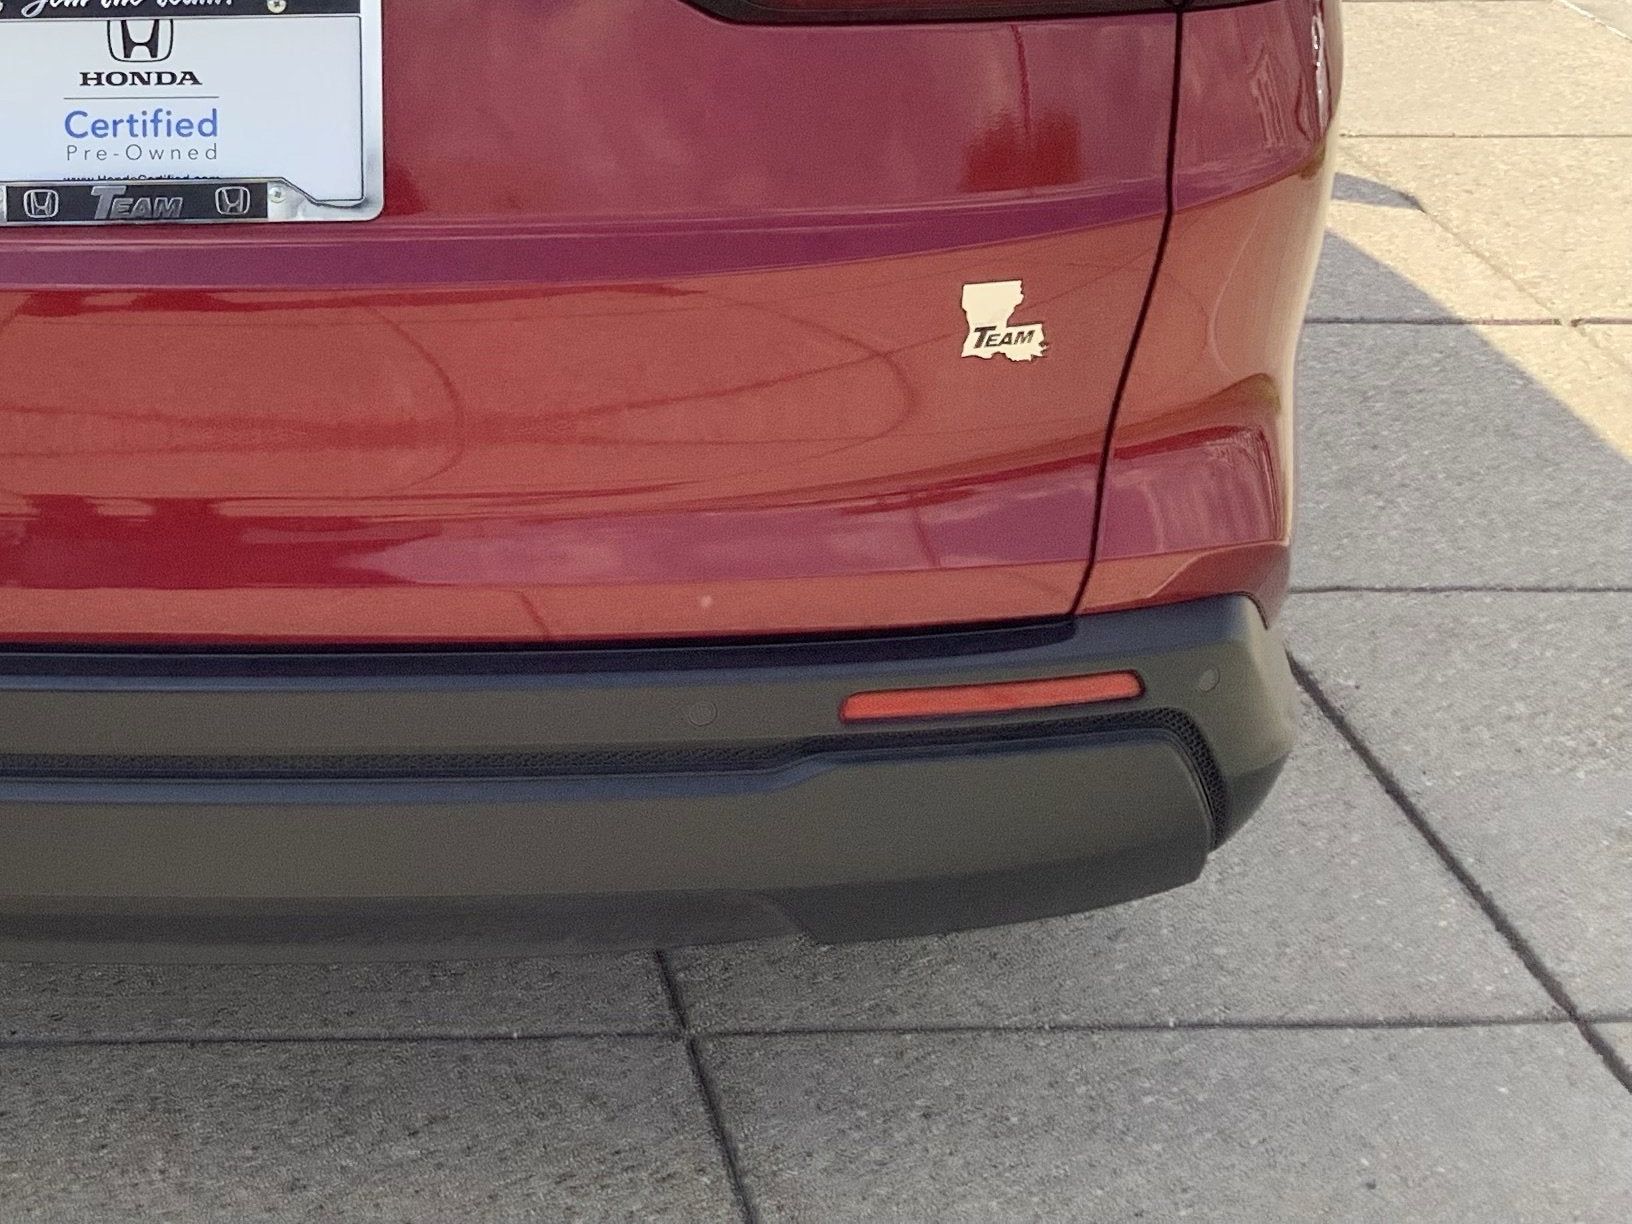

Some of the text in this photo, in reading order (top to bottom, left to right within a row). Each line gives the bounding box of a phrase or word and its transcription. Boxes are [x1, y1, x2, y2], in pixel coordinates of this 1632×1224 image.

[79, 71, 203, 87] HONDA
[64, 107, 218, 139] Certified
[67, 142, 217, 161] Pre-Owned
